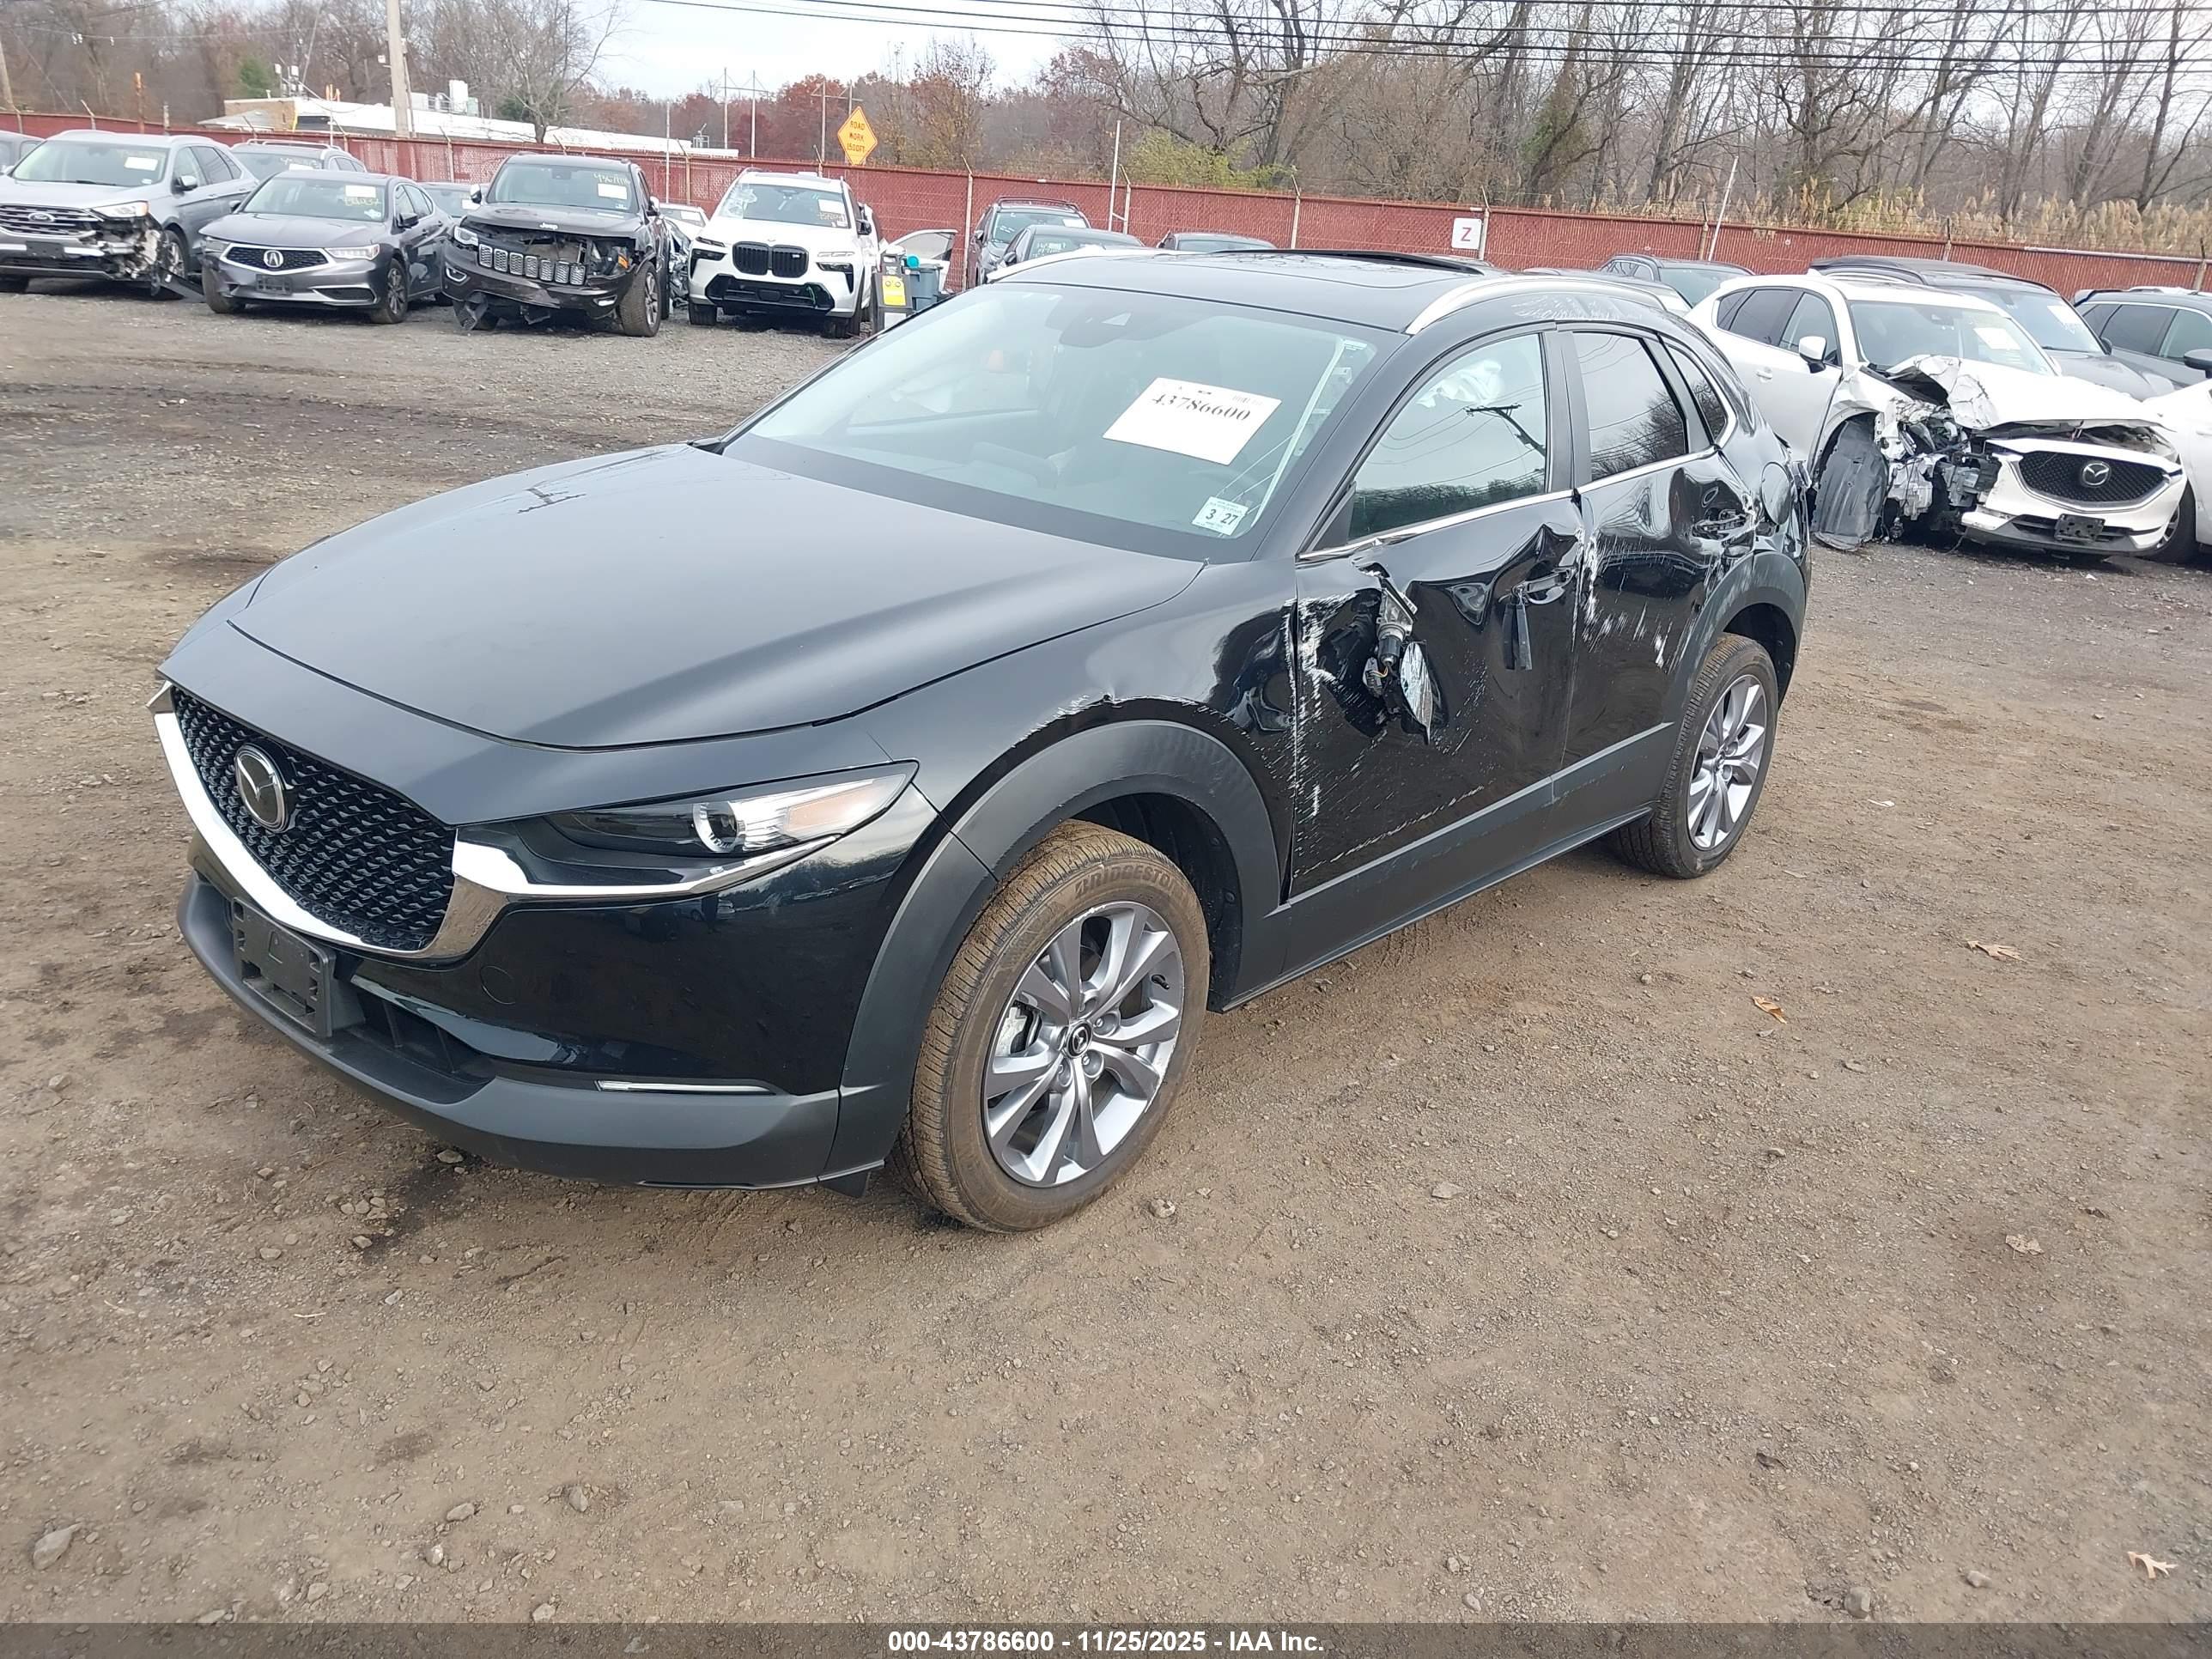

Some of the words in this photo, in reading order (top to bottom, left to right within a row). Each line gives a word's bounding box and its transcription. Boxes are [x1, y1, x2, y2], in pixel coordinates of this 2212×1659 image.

[850, 120, 866, 131] ROAD
[848, 132, 865, 142] WORK
[1460, 227, 1473, 242] Z
[1152, 394, 1251, 420] 43786600
[1206, 508, 1217, 520] 3
[1220, 513, 1239, 526] 27
